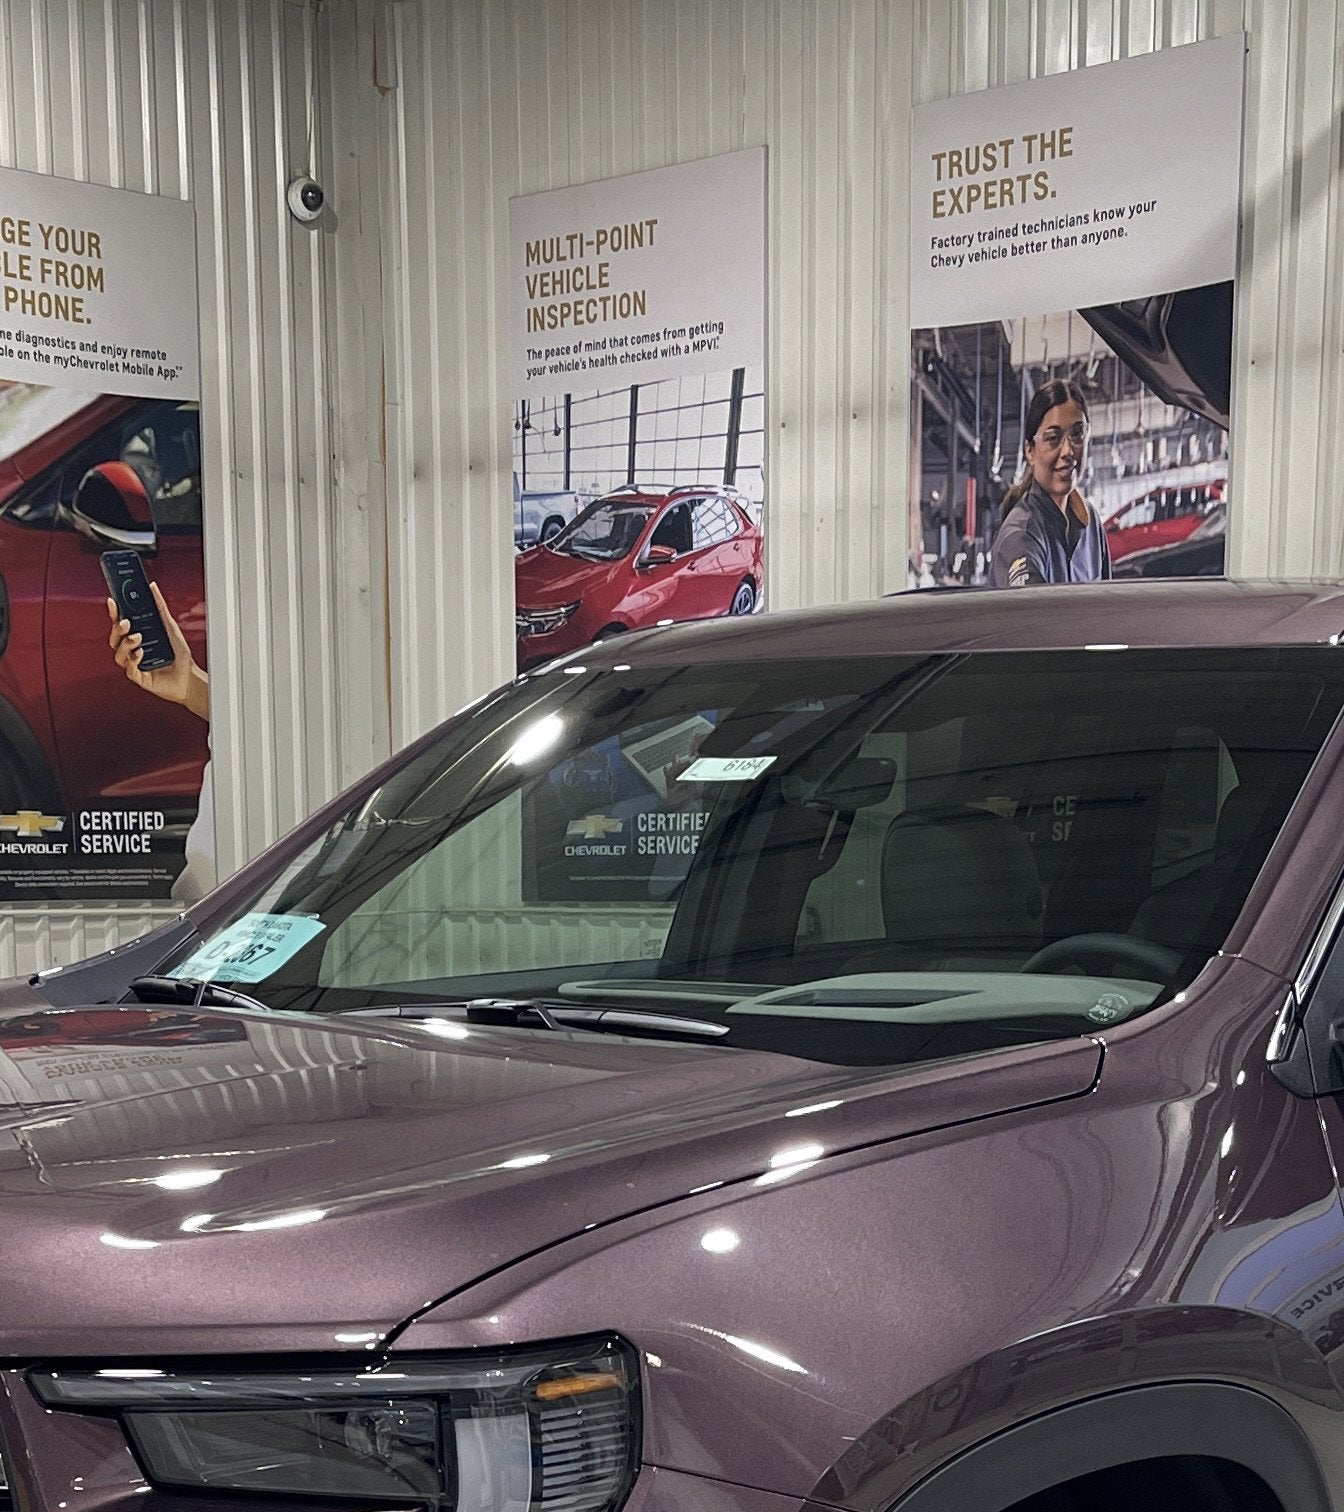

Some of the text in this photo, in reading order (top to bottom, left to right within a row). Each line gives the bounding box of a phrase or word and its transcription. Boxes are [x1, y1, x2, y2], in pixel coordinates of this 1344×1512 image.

[931, 126, 1074, 182] TRUST THE
[932, 171, 1057, 219] EXPERTS.
[38, 223, 102, 259] YOUR
[525, 218, 658, 267] MULTI-POINT
[931, 200, 1157, 250] Factory trained technicians know your
[931, 226, 1128, 268] Chevy vehicle better than anyone.
[40, 258, 105, 293] FROM
[525, 262, 610, 300] VEHICLE
[5, 285, 92, 324] PHONE.
[526, 290, 647, 333] INSPECTION
[15, 329, 76, 350] diagnostics
[79, 341, 98, 353] and
[100, 343, 128, 359] enjoy
[130, 348, 167, 361] remote
[526, 320, 724, 362] The peace of mind that comes from getting
[17, 349, 31, 361] on
[33, 350, 51, 364] the
[53, 355, 120, 374] myChevrolet
[122, 361, 155, 377] Mobile
[526, 366, 547, 381] your
[548, 358, 587, 375] vehicle's
[589, 354, 618, 369] health
[620, 347, 658, 364] checked
[661, 343, 682, 358] with
[684, 345, 690, 355] a
[80, 811, 165, 832] CERTIFIED
[81, 834, 152, 854] SERVICE
[564, 845, 627, 857] CHEVROLET
